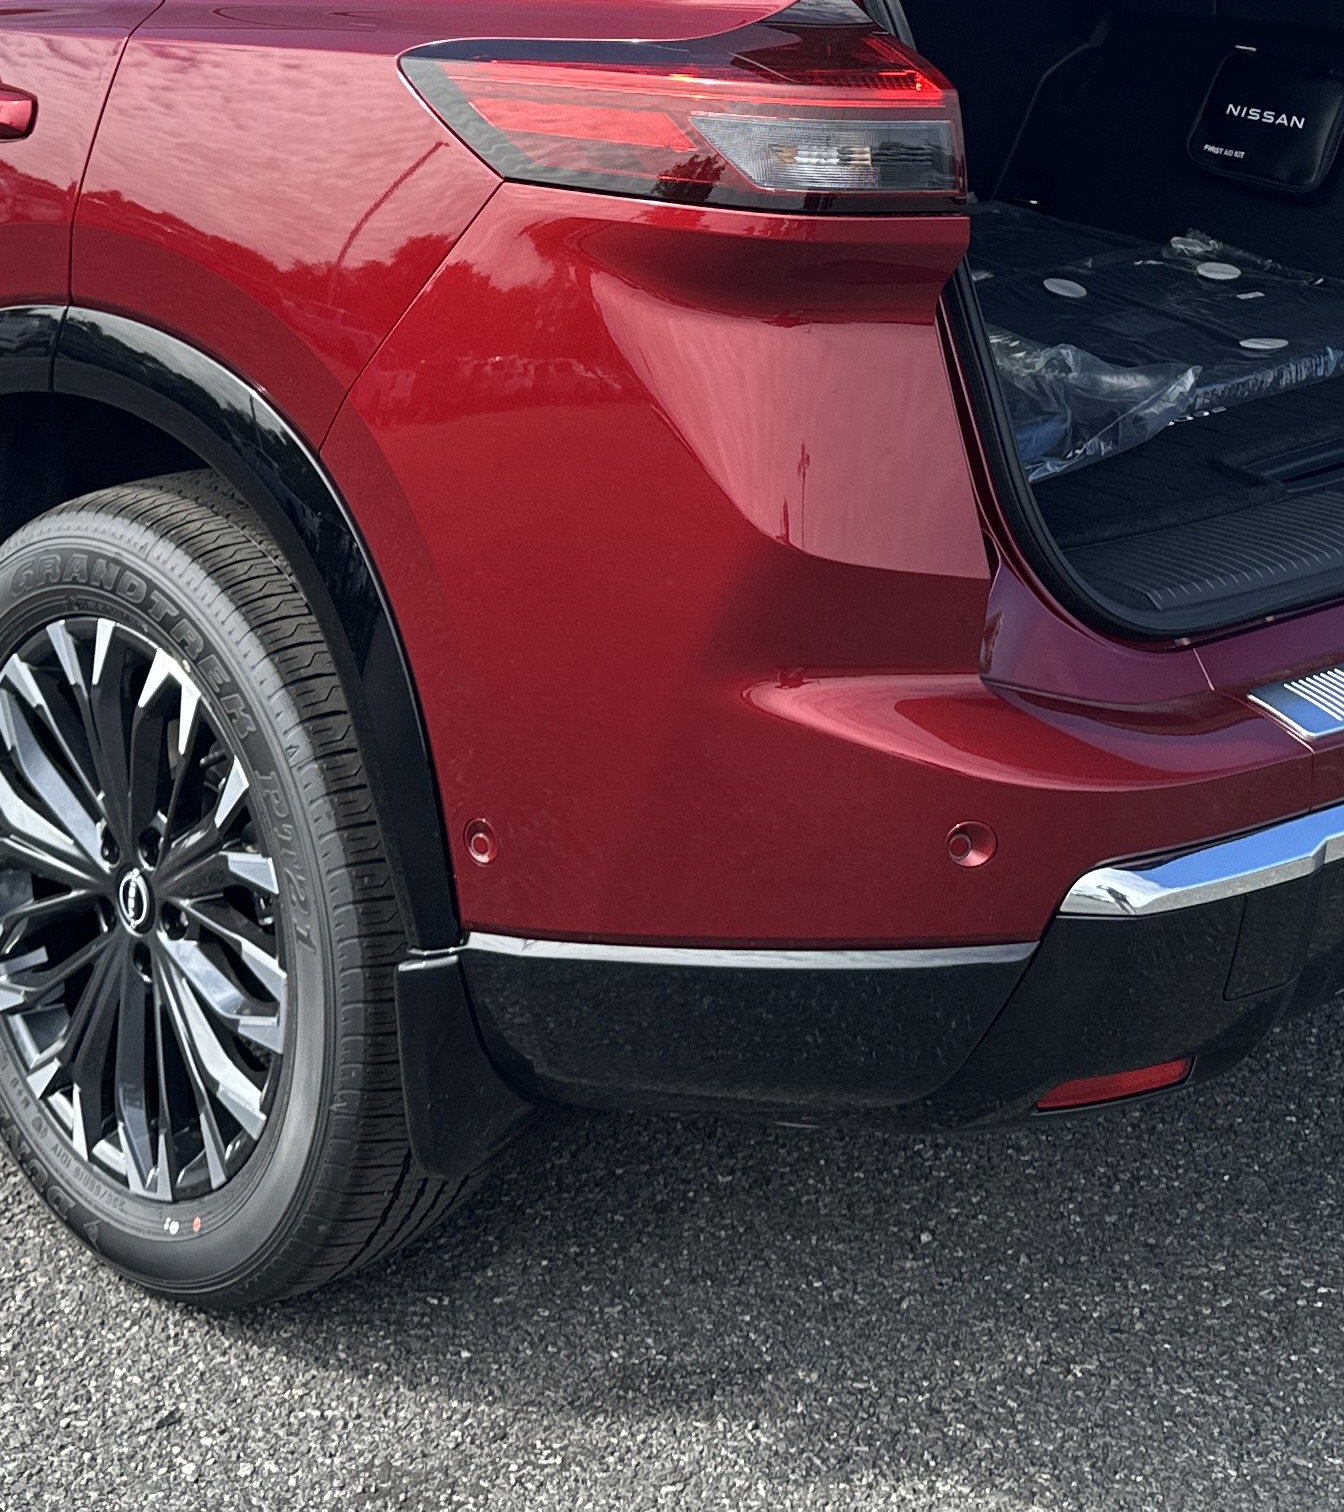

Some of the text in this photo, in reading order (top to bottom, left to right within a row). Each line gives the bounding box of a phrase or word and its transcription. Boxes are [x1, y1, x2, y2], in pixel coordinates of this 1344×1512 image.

[1225, 103, 1305, 129] NISSAN
[1203, 143, 1224, 155] FIRST
[11, 553, 257, 740] GRANDTREK
